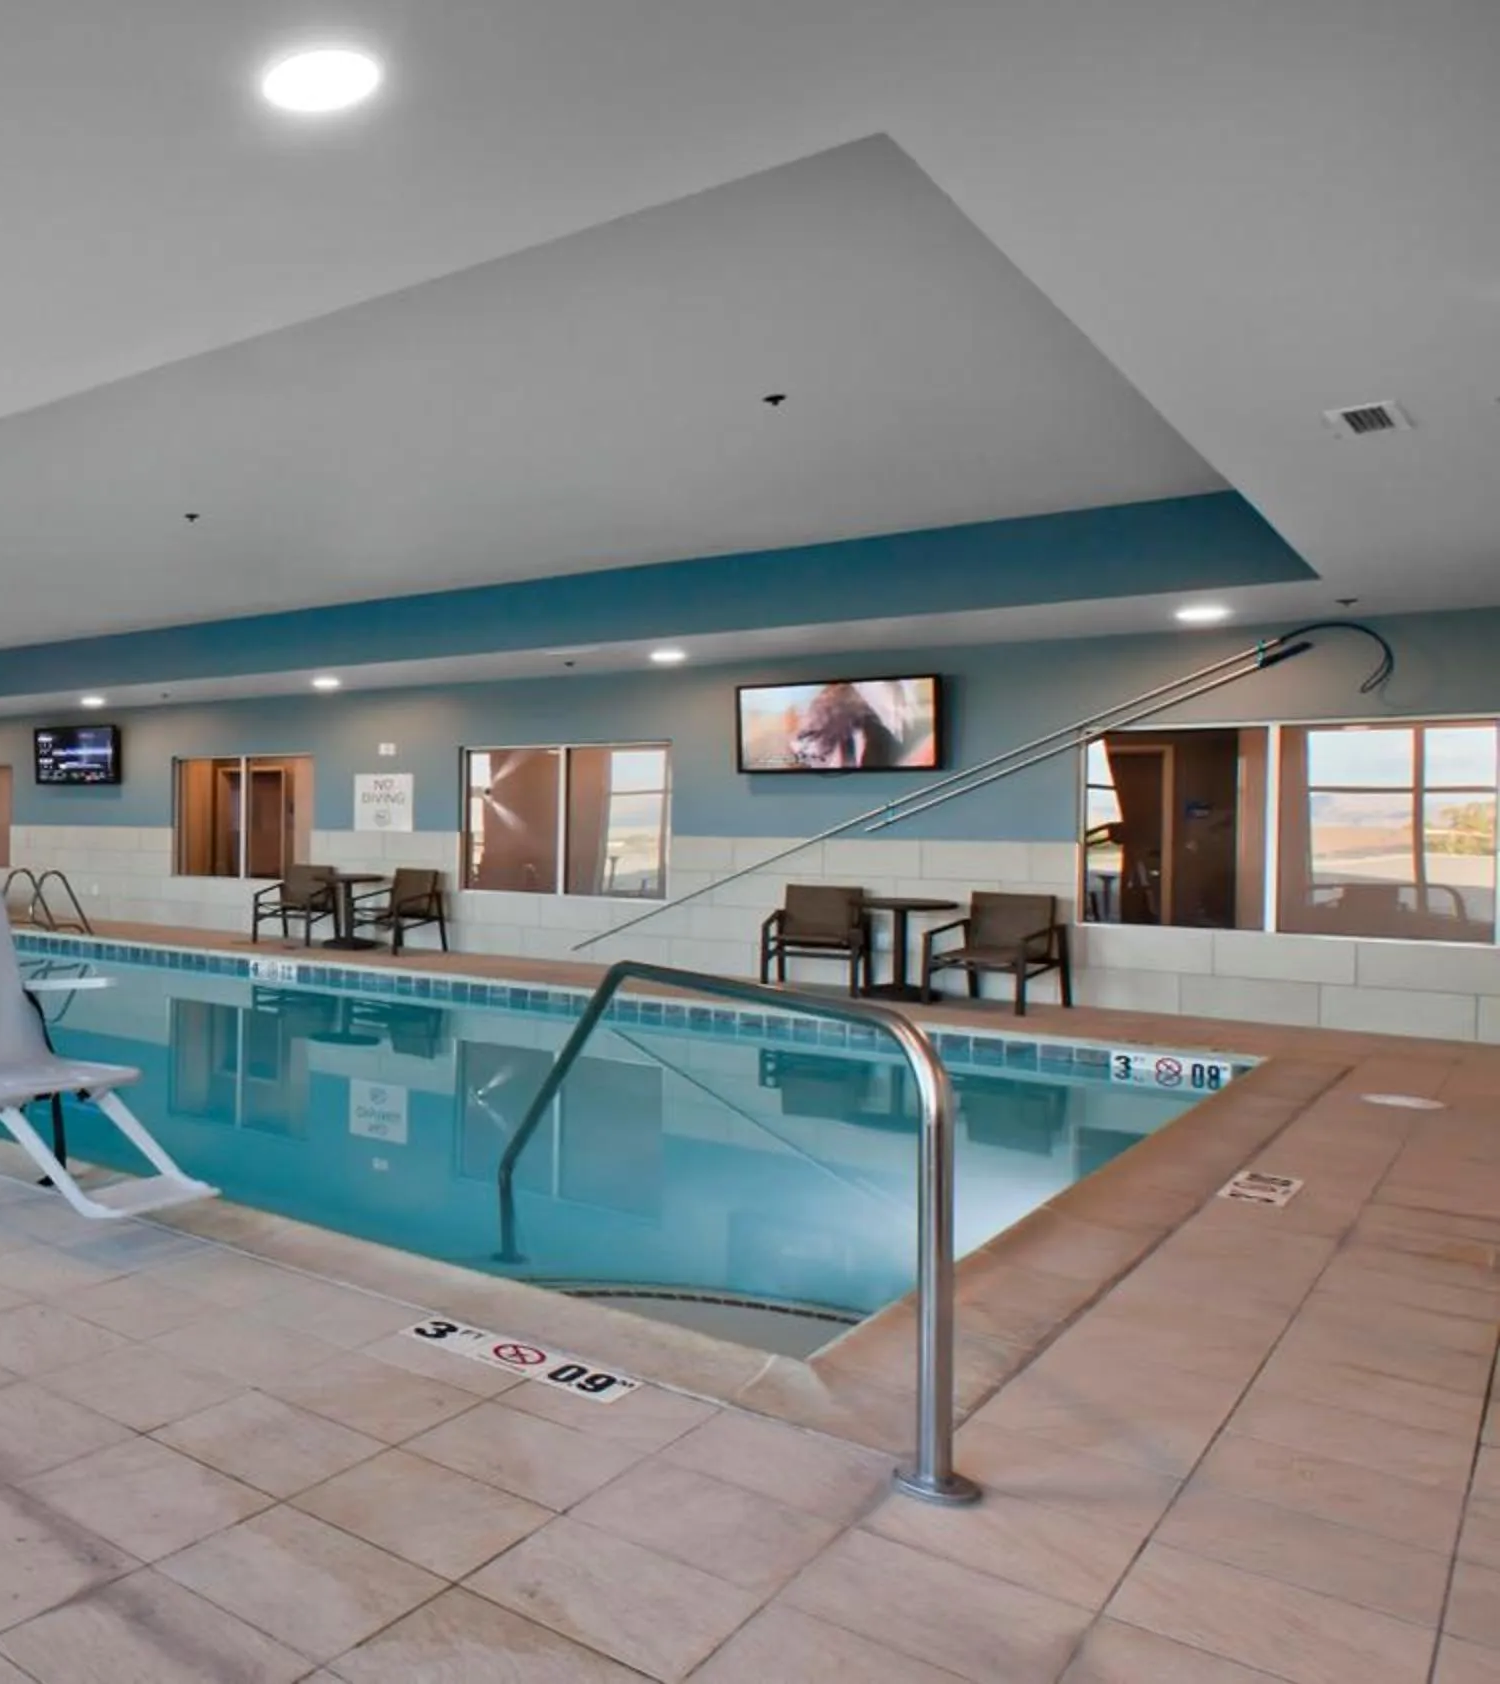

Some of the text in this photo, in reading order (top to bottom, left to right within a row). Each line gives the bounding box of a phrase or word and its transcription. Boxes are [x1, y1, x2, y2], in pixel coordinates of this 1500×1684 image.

[373, 778, 395, 792] NO
[361, 792, 405, 805] DIVING
[414, 1321, 458, 1339] 3
